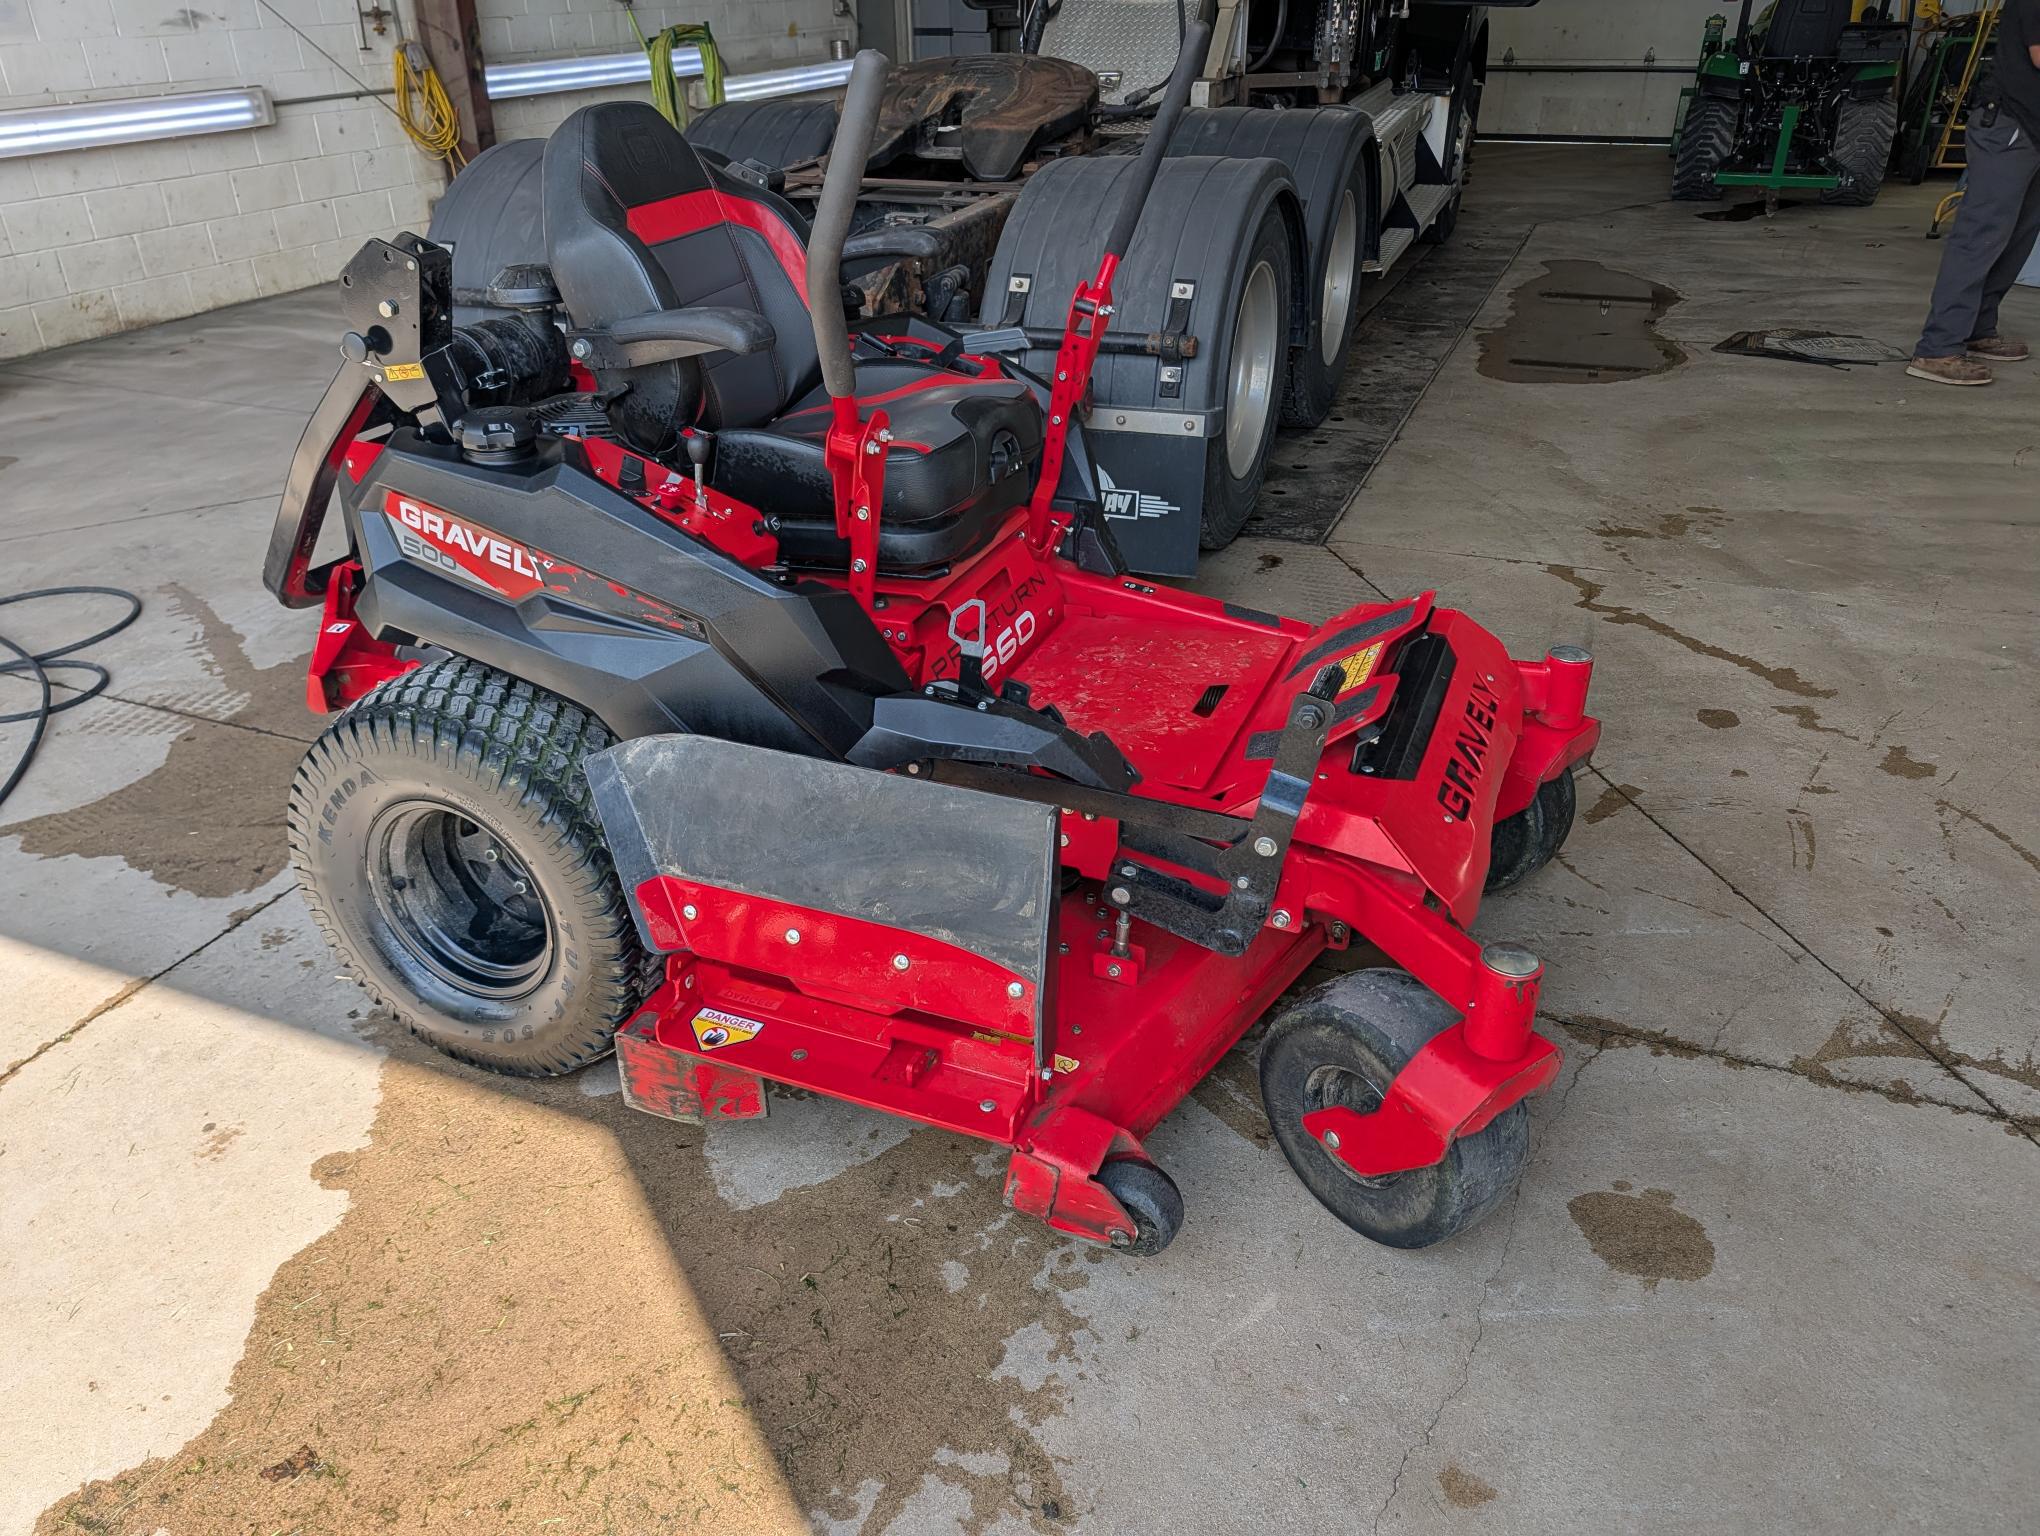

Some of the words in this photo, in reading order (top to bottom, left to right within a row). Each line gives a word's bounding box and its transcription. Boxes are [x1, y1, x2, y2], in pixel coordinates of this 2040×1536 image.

[403, 535, 457, 571] 500
[986, 569, 1046, 626] TURN
[982, 611, 1036, 681] 560
[1437, 672, 1501, 822] GRAVELY
[318, 770, 376, 847] KENDA
[705, 1011, 756, 1030] DANGER
